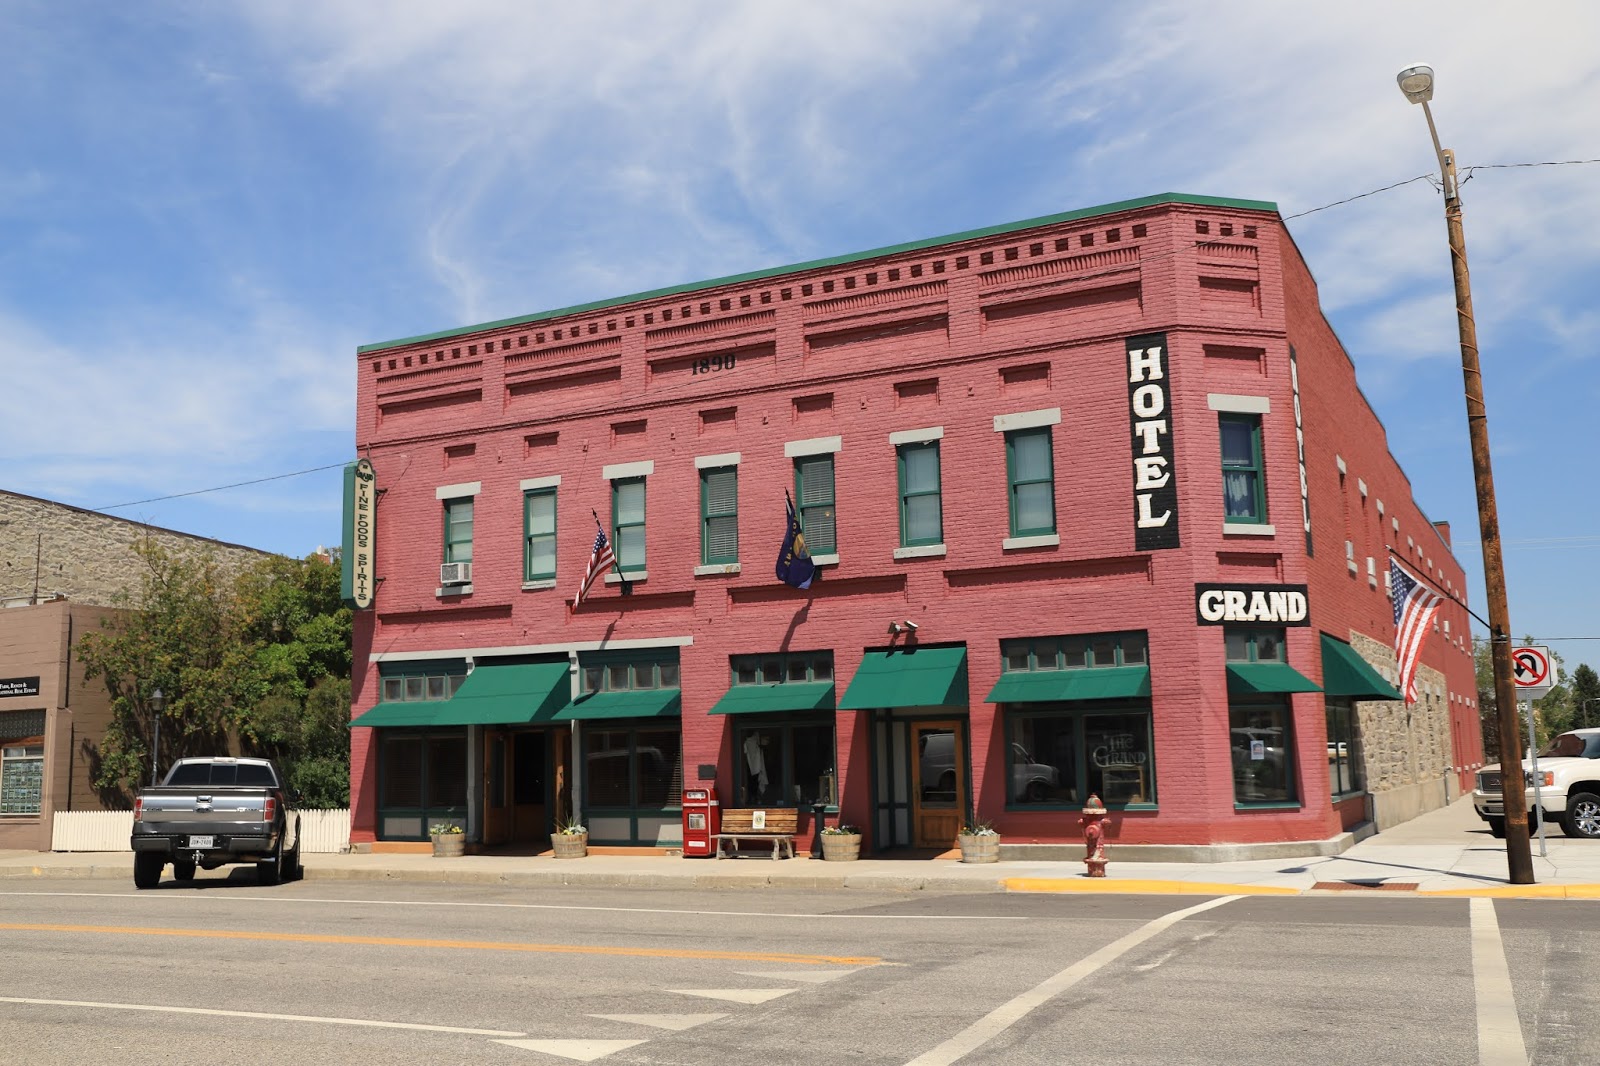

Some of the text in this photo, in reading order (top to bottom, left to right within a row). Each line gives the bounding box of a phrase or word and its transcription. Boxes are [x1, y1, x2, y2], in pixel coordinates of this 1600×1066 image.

[692, 352, 736, 376] 1890
[1129, 346, 1172, 529] HOTEL
[359, 483, 369, 511] FINE
[357, 514, 369, 548] FOODS
[357, 553, 368, 601] SPIRITS
[1199, 590, 1307, 622] GRAND
[1093, 746, 1146, 767] GRAND
